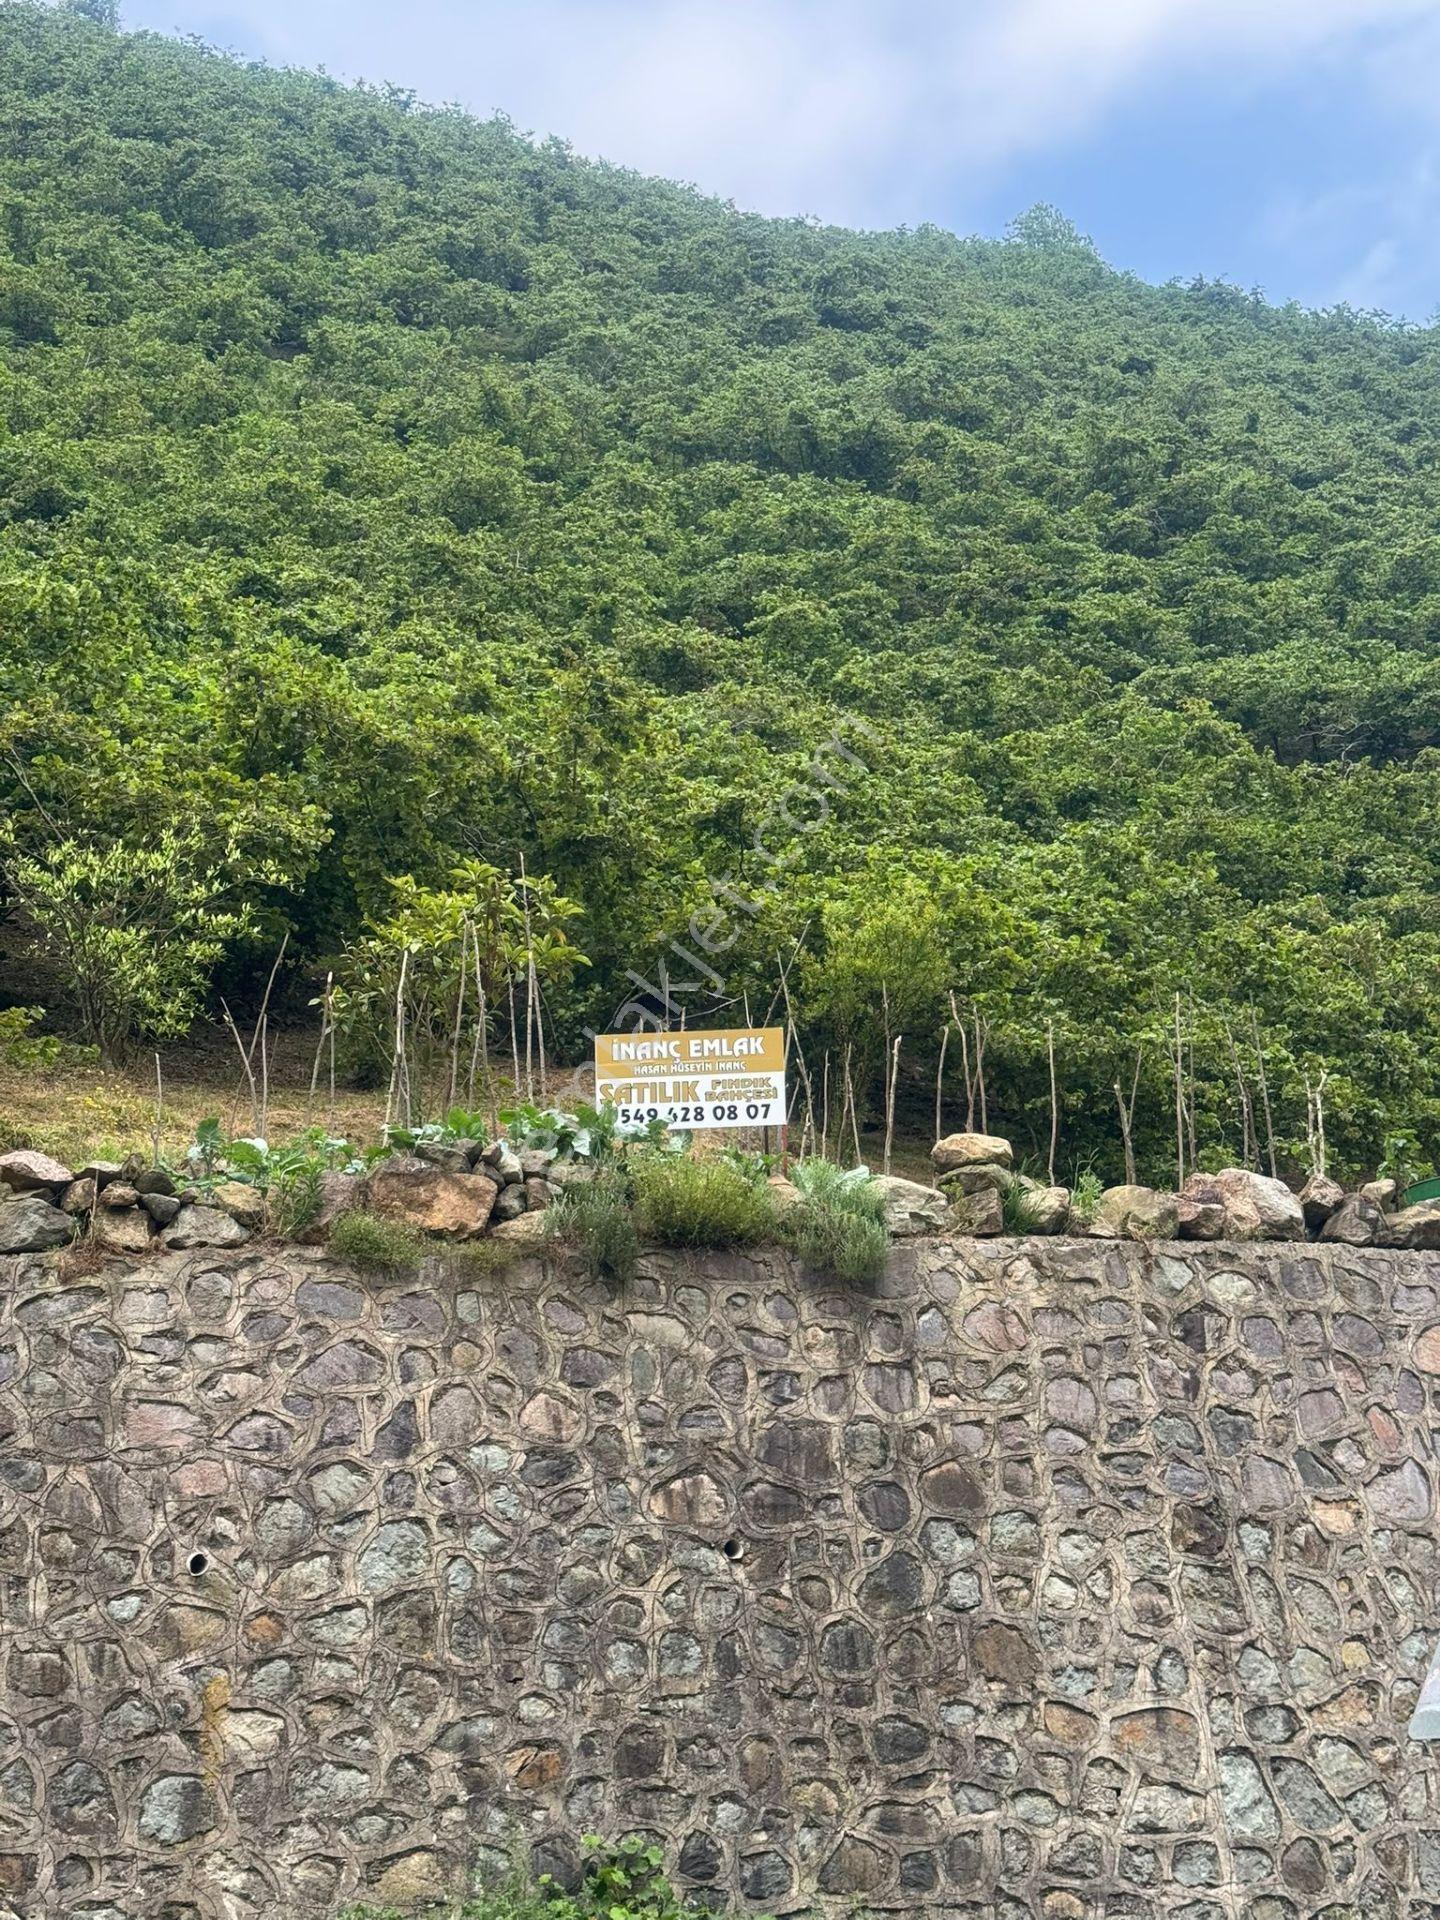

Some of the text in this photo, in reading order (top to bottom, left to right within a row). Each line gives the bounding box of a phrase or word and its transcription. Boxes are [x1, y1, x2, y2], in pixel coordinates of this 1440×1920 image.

[612, 1036, 765, 1064] İNANÇ EMLAK
[634, 1061, 746, 1075] HASAN HÜSEYİN İNANÇ
[711, 1077, 771, 1090] FINDIK
[599, 1080, 700, 1107] SATILIK
[705, 1087, 778, 1102] BAHÇESİ
[712, 1105, 738, 1121] 08
[746, 1103, 771, 1120] 07
